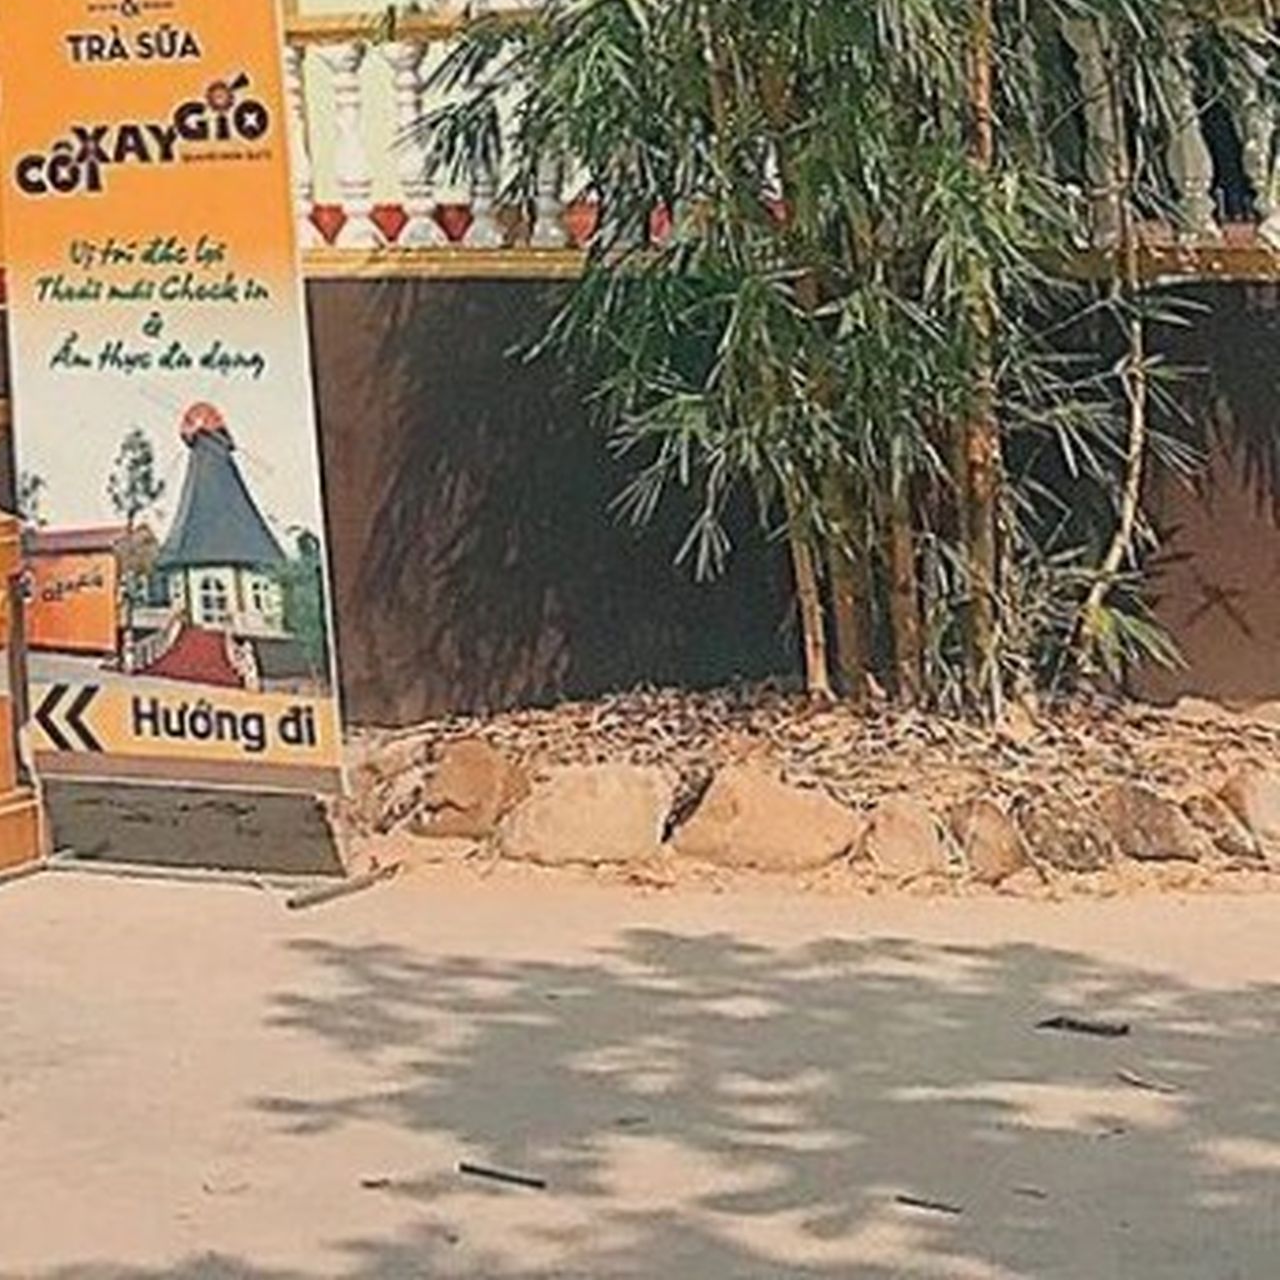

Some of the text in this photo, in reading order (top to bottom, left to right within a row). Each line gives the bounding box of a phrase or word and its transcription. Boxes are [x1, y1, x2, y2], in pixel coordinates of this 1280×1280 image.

[65, 24, 130, 62] TRÀ
[132, 696, 317, 753] Hướng đi
